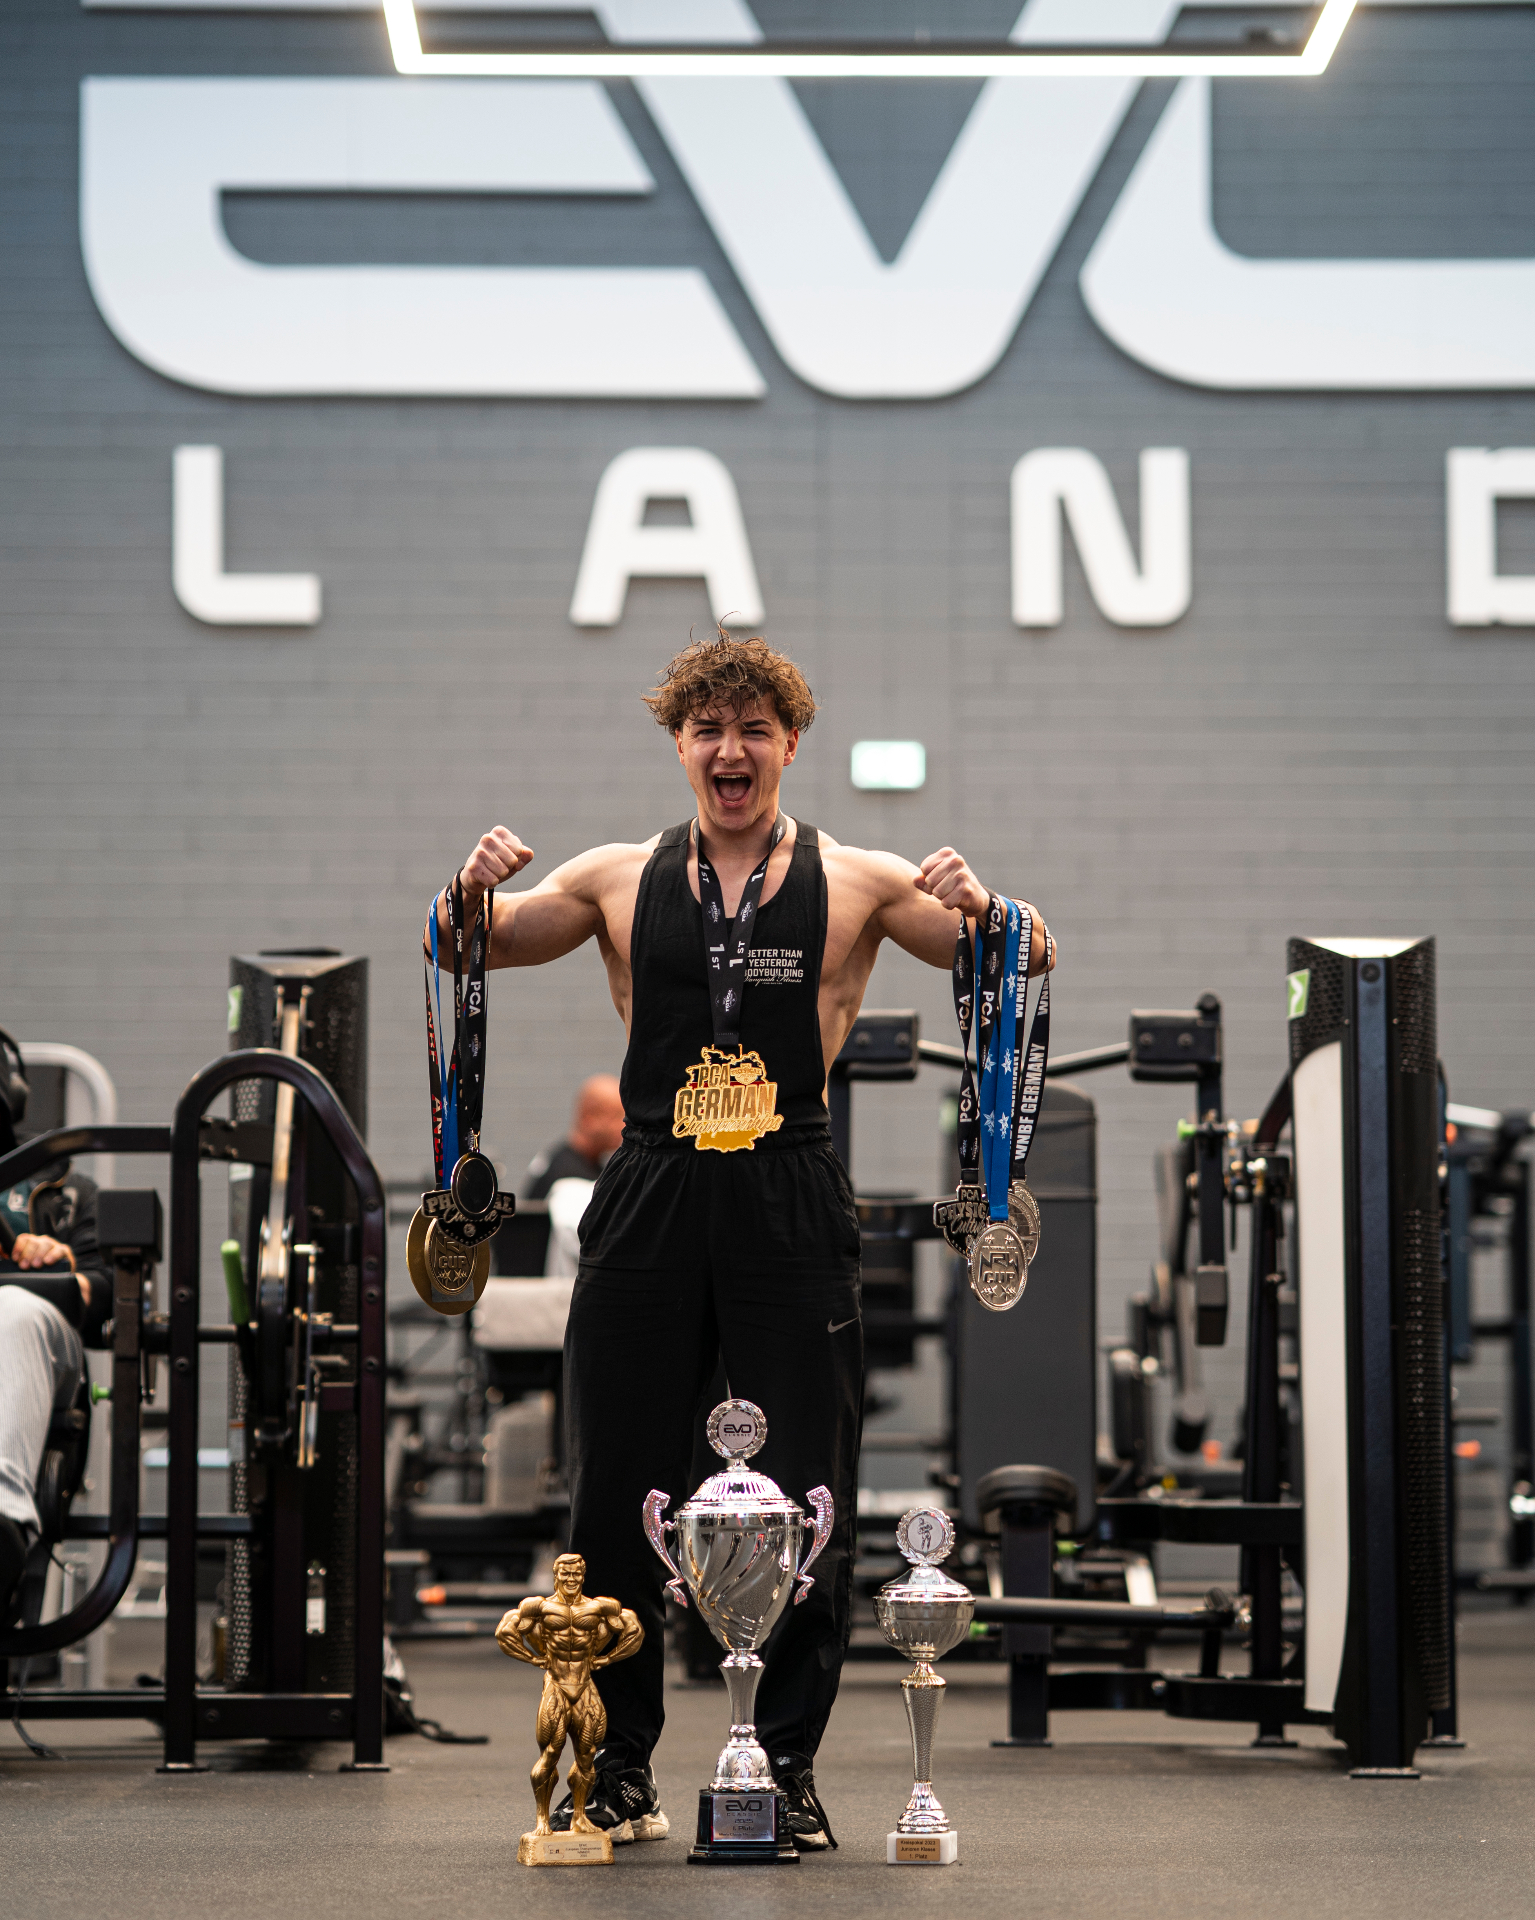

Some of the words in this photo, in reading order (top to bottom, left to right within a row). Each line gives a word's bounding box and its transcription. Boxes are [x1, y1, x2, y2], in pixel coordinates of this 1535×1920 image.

[988, 897, 1002, 935] PCA
[748, 958, 799, 968] YESTERDAY
[780, 949, 803, 959] THAN
[469, 980, 482, 1018] PCA
[1014, 974, 1027, 1018] WNBF
[958, 993, 971, 1031] PCA
[980, 990, 995, 1028] PCA
[698, 1063, 731, 1088] PCA
[1020, 1042, 1046, 1114] GERMANY
[675, 1083, 777, 1121] GERMAN
[959, 1085, 973, 1123] PCA
[673, 1113, 783, 1138] Championships
[1014, 1115, 1035, 1161] WNBF
[961, 1189, 980, 1201] PCA
[938, 1202, 990, 1223] PHYSIC
[438, 1255, 467, 1269] CUP
[983, 1270, 1016, 1283] CUP
[723, 1424, 752, 1434] EVO
[725, 1799, 763, 1812] EVO
